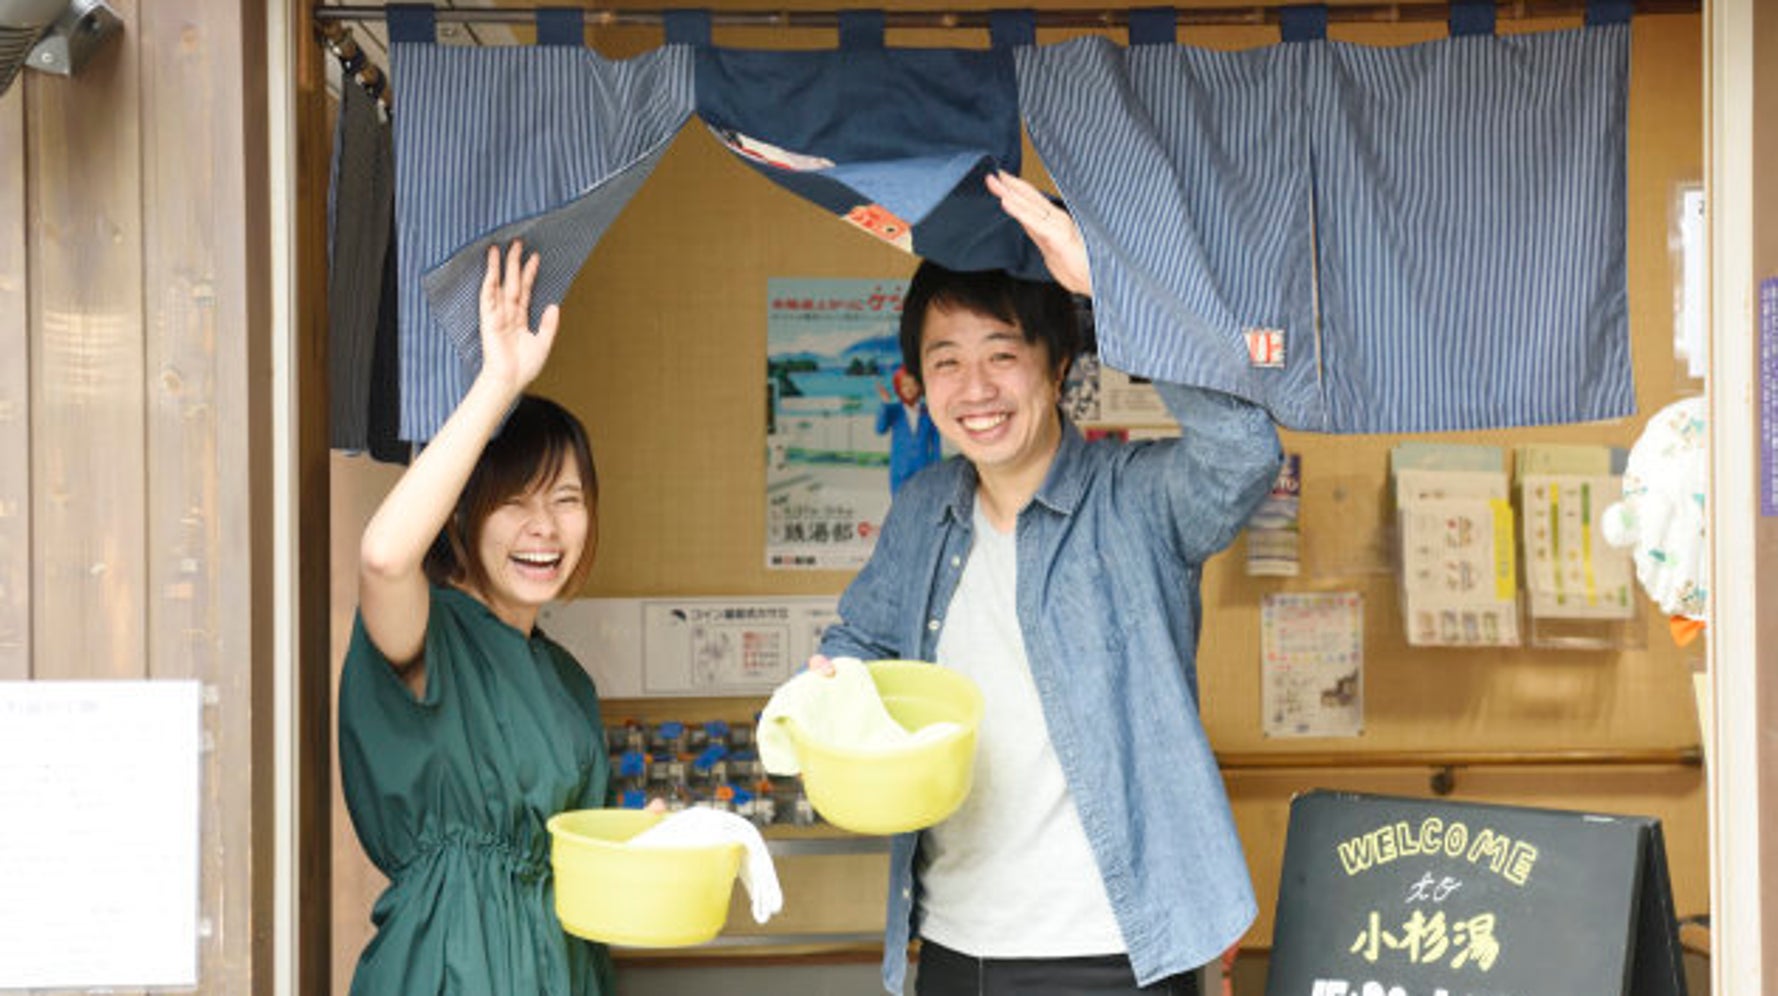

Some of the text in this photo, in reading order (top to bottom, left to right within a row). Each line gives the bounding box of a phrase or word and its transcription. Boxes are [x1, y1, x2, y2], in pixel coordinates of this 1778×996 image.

[1337, 816, 1538, 887] WELCOME
[1349, 910, 1500, 971] 小杉湯
